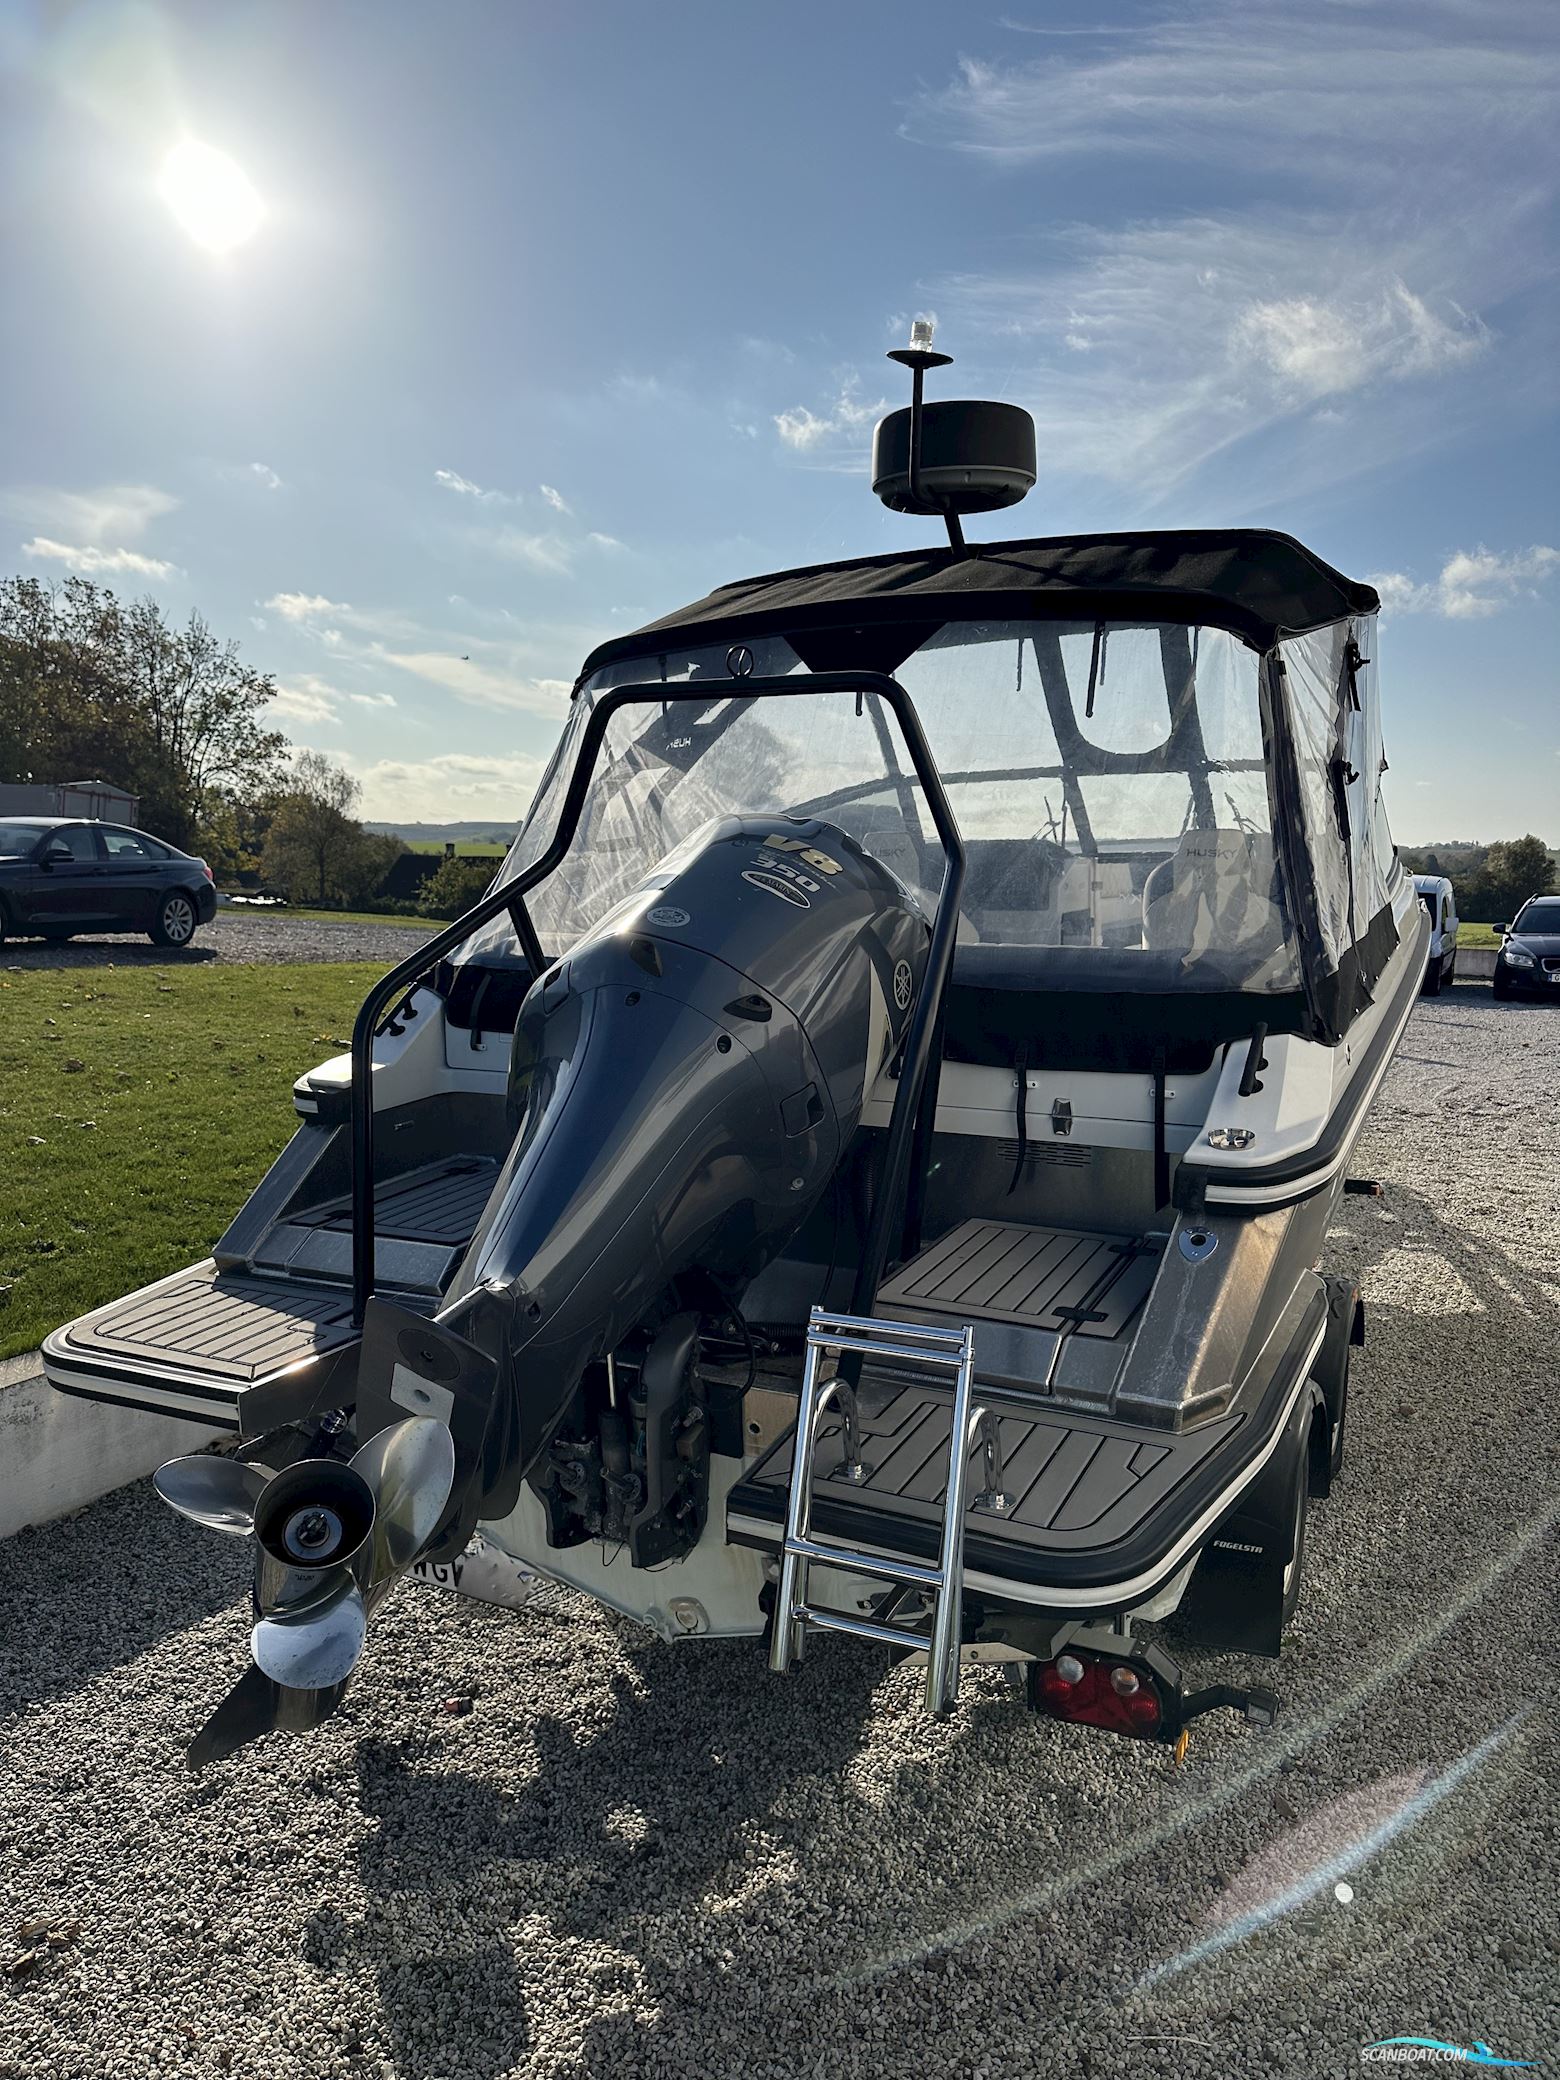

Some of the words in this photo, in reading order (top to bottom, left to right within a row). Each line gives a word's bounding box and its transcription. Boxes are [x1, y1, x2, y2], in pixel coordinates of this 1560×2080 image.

[1186, 848, 1238, 860] HUSKY
[750, 859, 821, 893] 350
[1213, 1539, 1263, 1554] FOGELSTA
